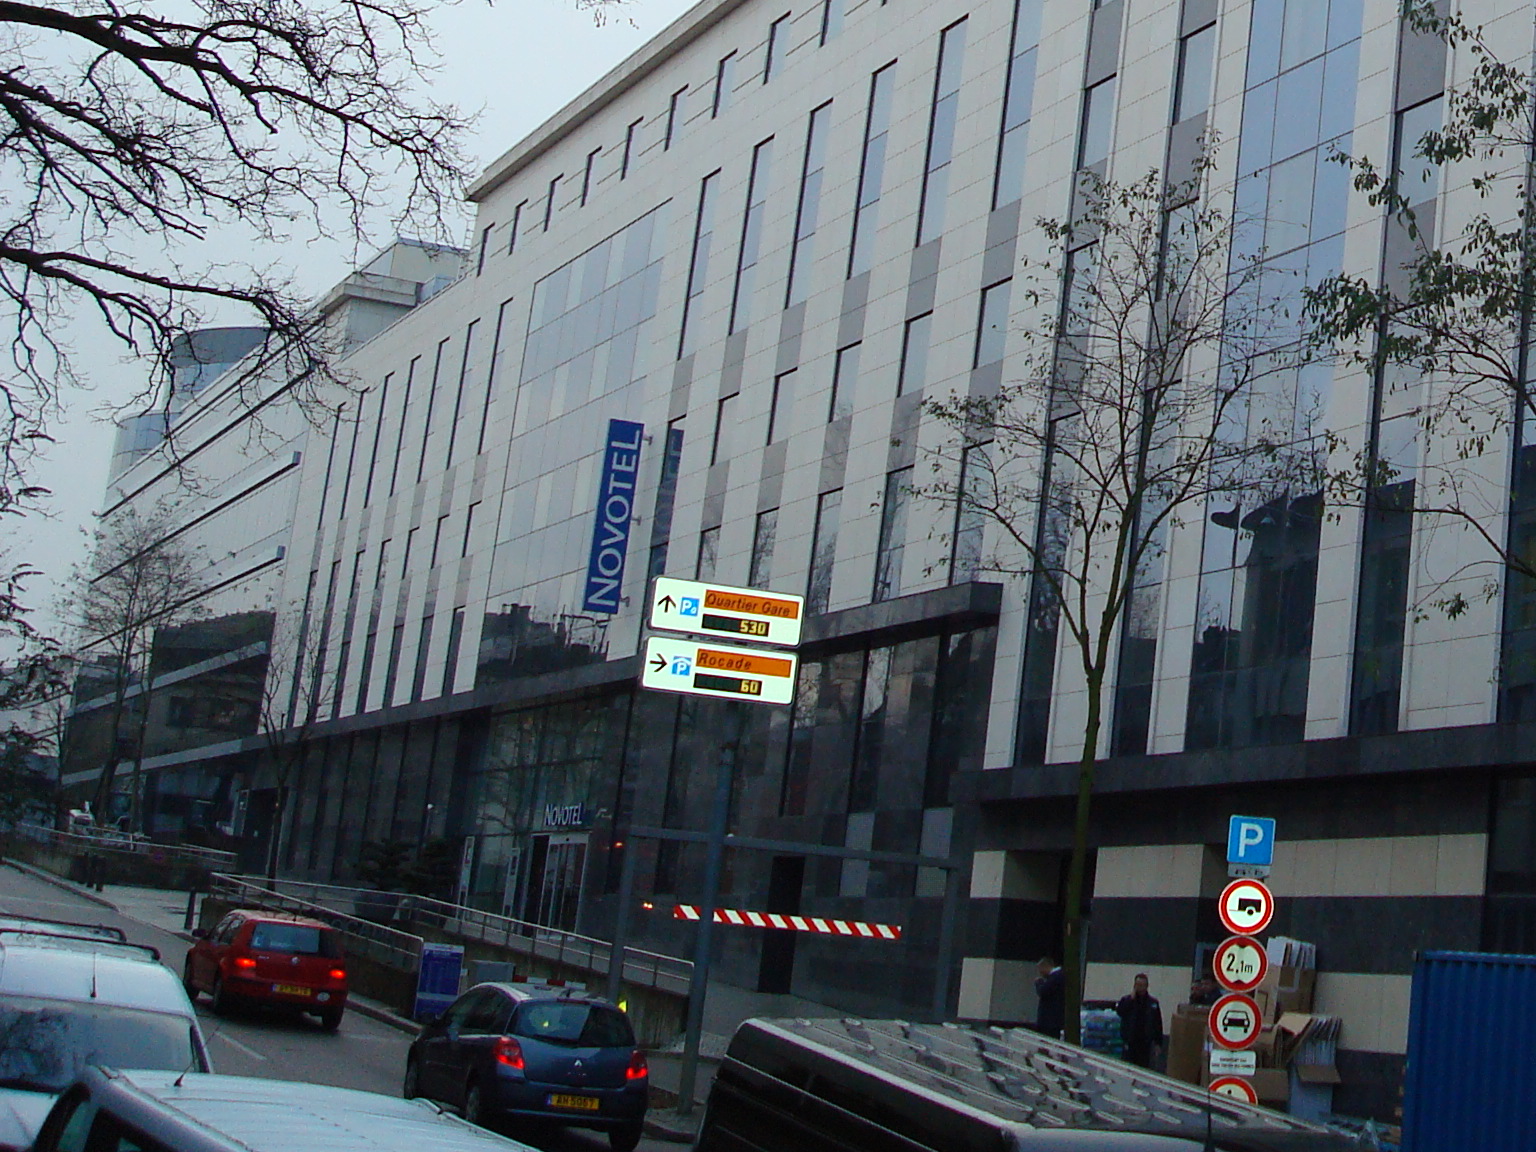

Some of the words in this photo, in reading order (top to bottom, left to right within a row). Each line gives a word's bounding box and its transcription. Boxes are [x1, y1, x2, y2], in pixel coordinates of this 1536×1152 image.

[588, 429, 640, 606] NOVOTEL
[706, 593, 758, 611] Quartier
[762, 601, 791, 617] Gare
[740, 620, 766, 635] 530
[699, 653, 752, 670] Rocade
[741, 680, 759, 693] 60
[544, 802, 583, 826] NOVOTEL
[1238, 822, 1264, 857] P
